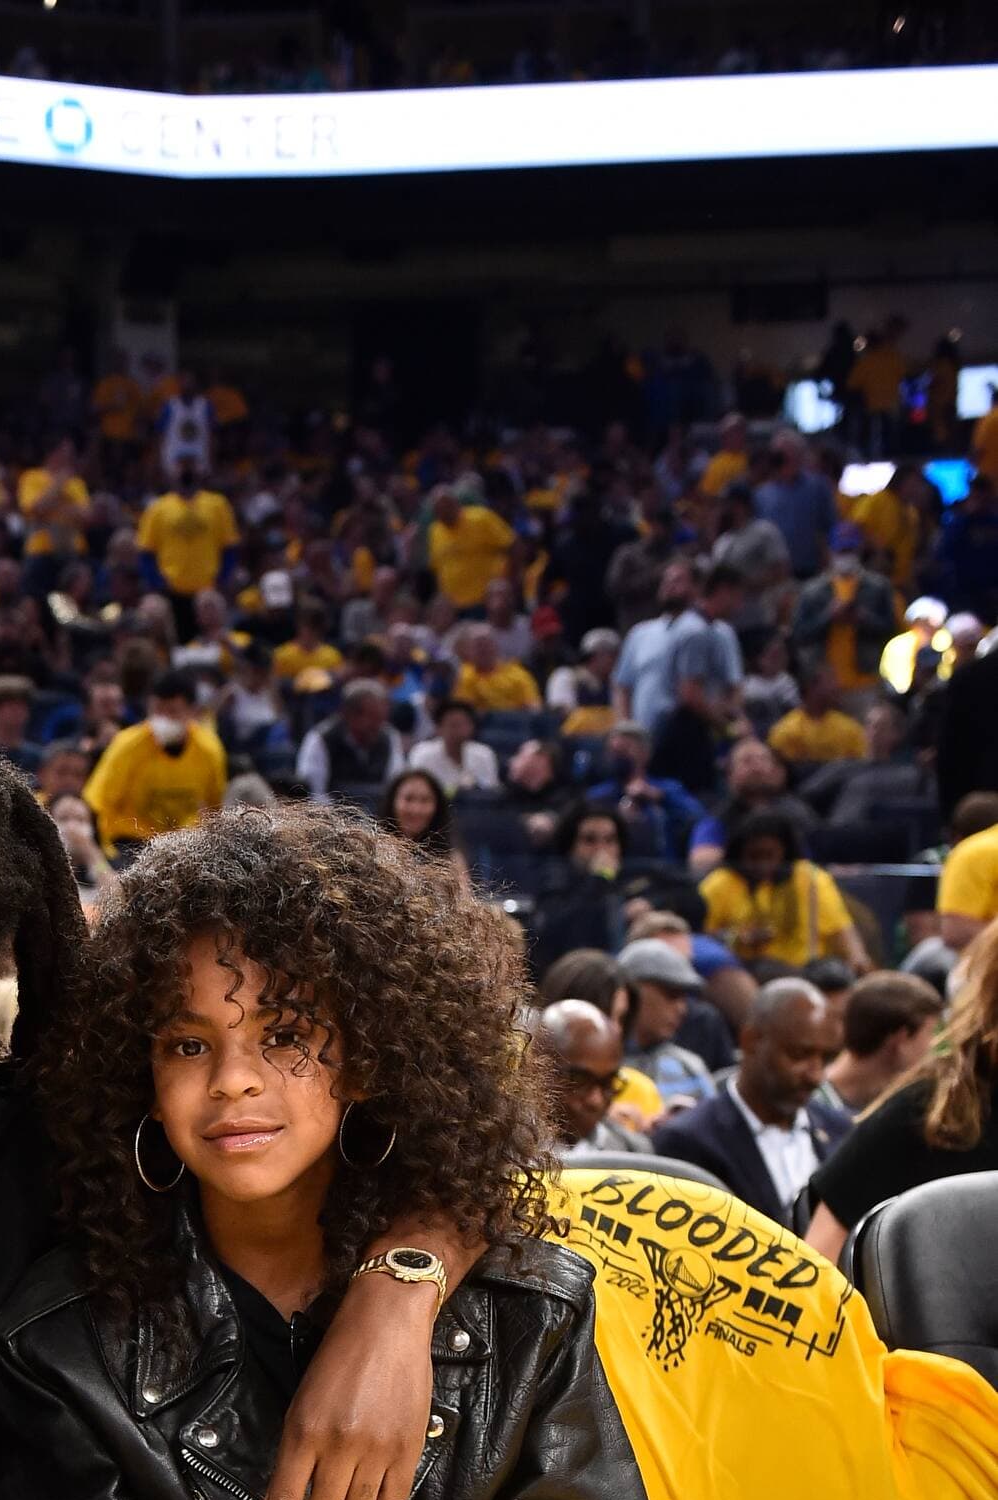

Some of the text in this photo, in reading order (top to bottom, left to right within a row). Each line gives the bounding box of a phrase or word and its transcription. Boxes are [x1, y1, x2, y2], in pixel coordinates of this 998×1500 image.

[120, 110, 339, 158] CENTER
[581, 1174, 819, 1289] BLOODED
[606, 1271, 649, 1300] 2022
[705, 1320, 758, 1357] FINALS
